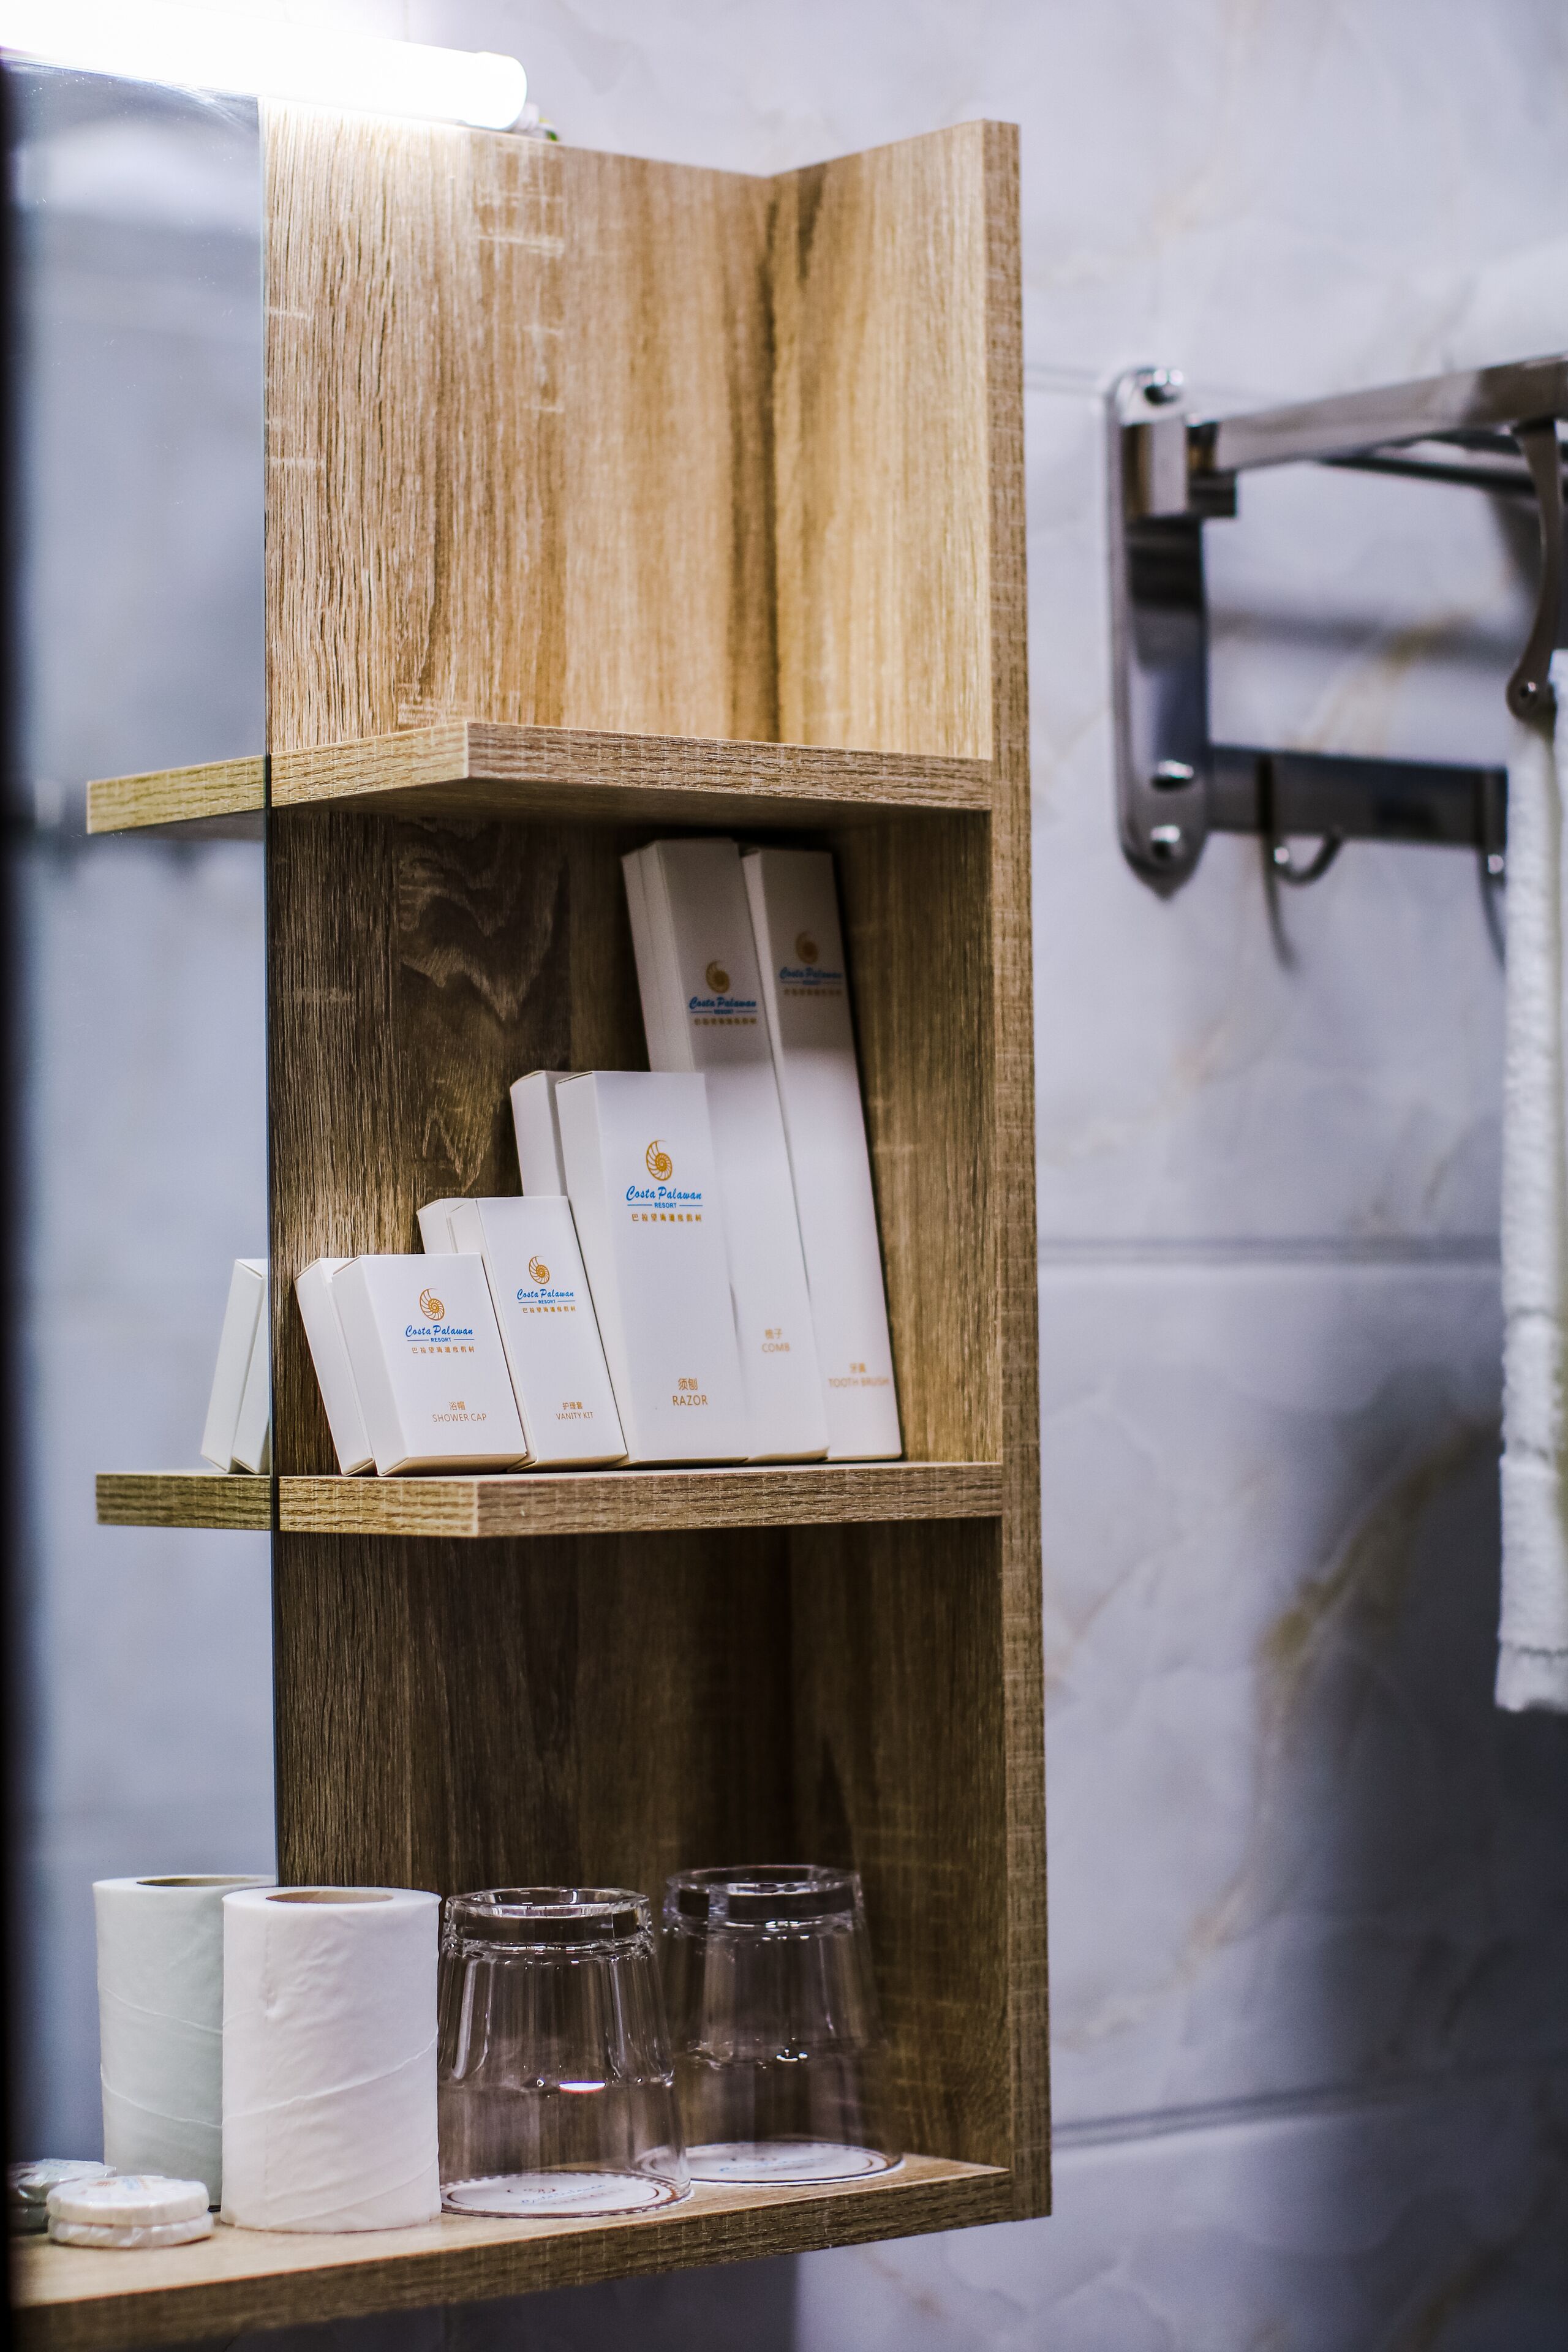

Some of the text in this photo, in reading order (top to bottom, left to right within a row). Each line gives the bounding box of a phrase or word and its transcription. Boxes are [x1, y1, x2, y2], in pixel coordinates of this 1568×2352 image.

[689, 997, 756, 1009] Costa Palawan
[626, 1186, 702, 1200] Costa Palawan
[517, 1288, 574, 1300] Costa Palawan
[405, 1325, 473, 1337] Costa Palawan
[762, 1343, 790, 1352] COMB
[678, 1378, 698, 1390] 须刨
[828, 1378, 858, 1387] TOOTH
[448, 1401, 466, 1410] 浴帽
[673, 1395, 708, 1406] RAZOR
